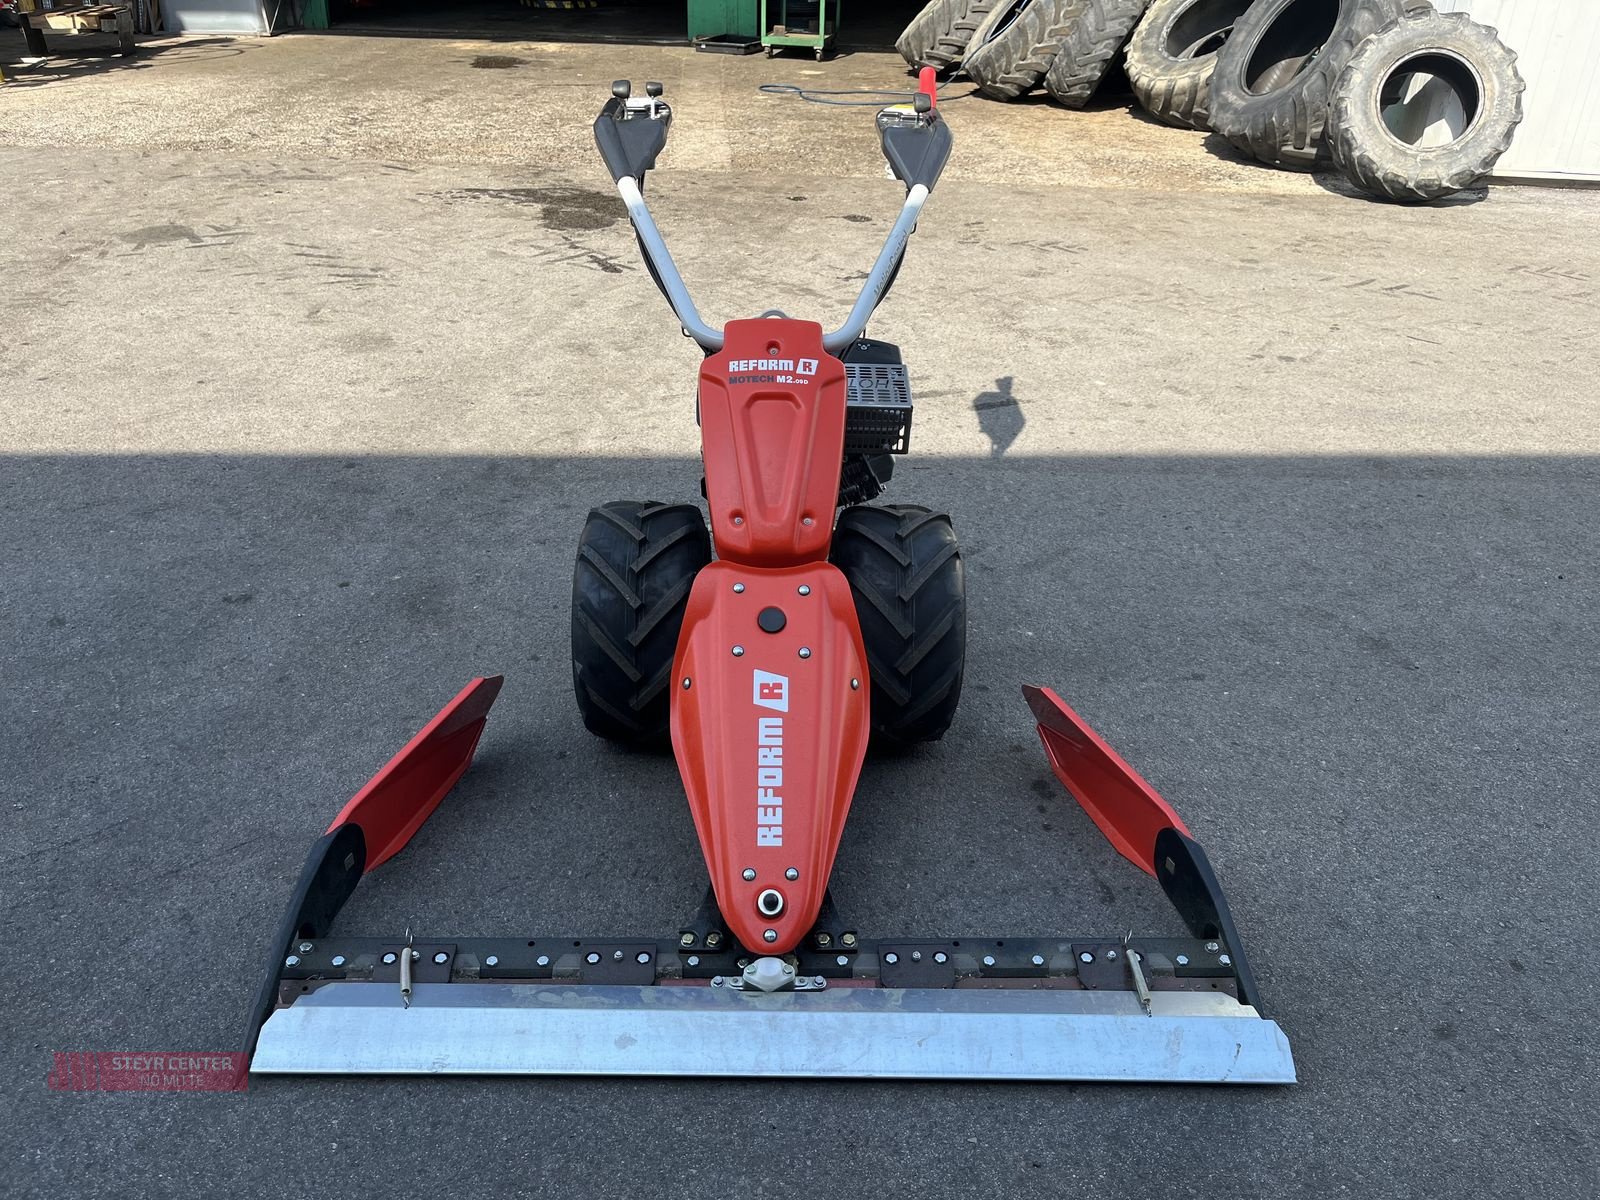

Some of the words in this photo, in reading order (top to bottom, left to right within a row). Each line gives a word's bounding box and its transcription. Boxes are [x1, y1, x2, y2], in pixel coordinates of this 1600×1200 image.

[729, 359, 794, 372] REFORM
[729, 375, 774, 384] MOTECH
[757, 717, 783, 847] REFORM
